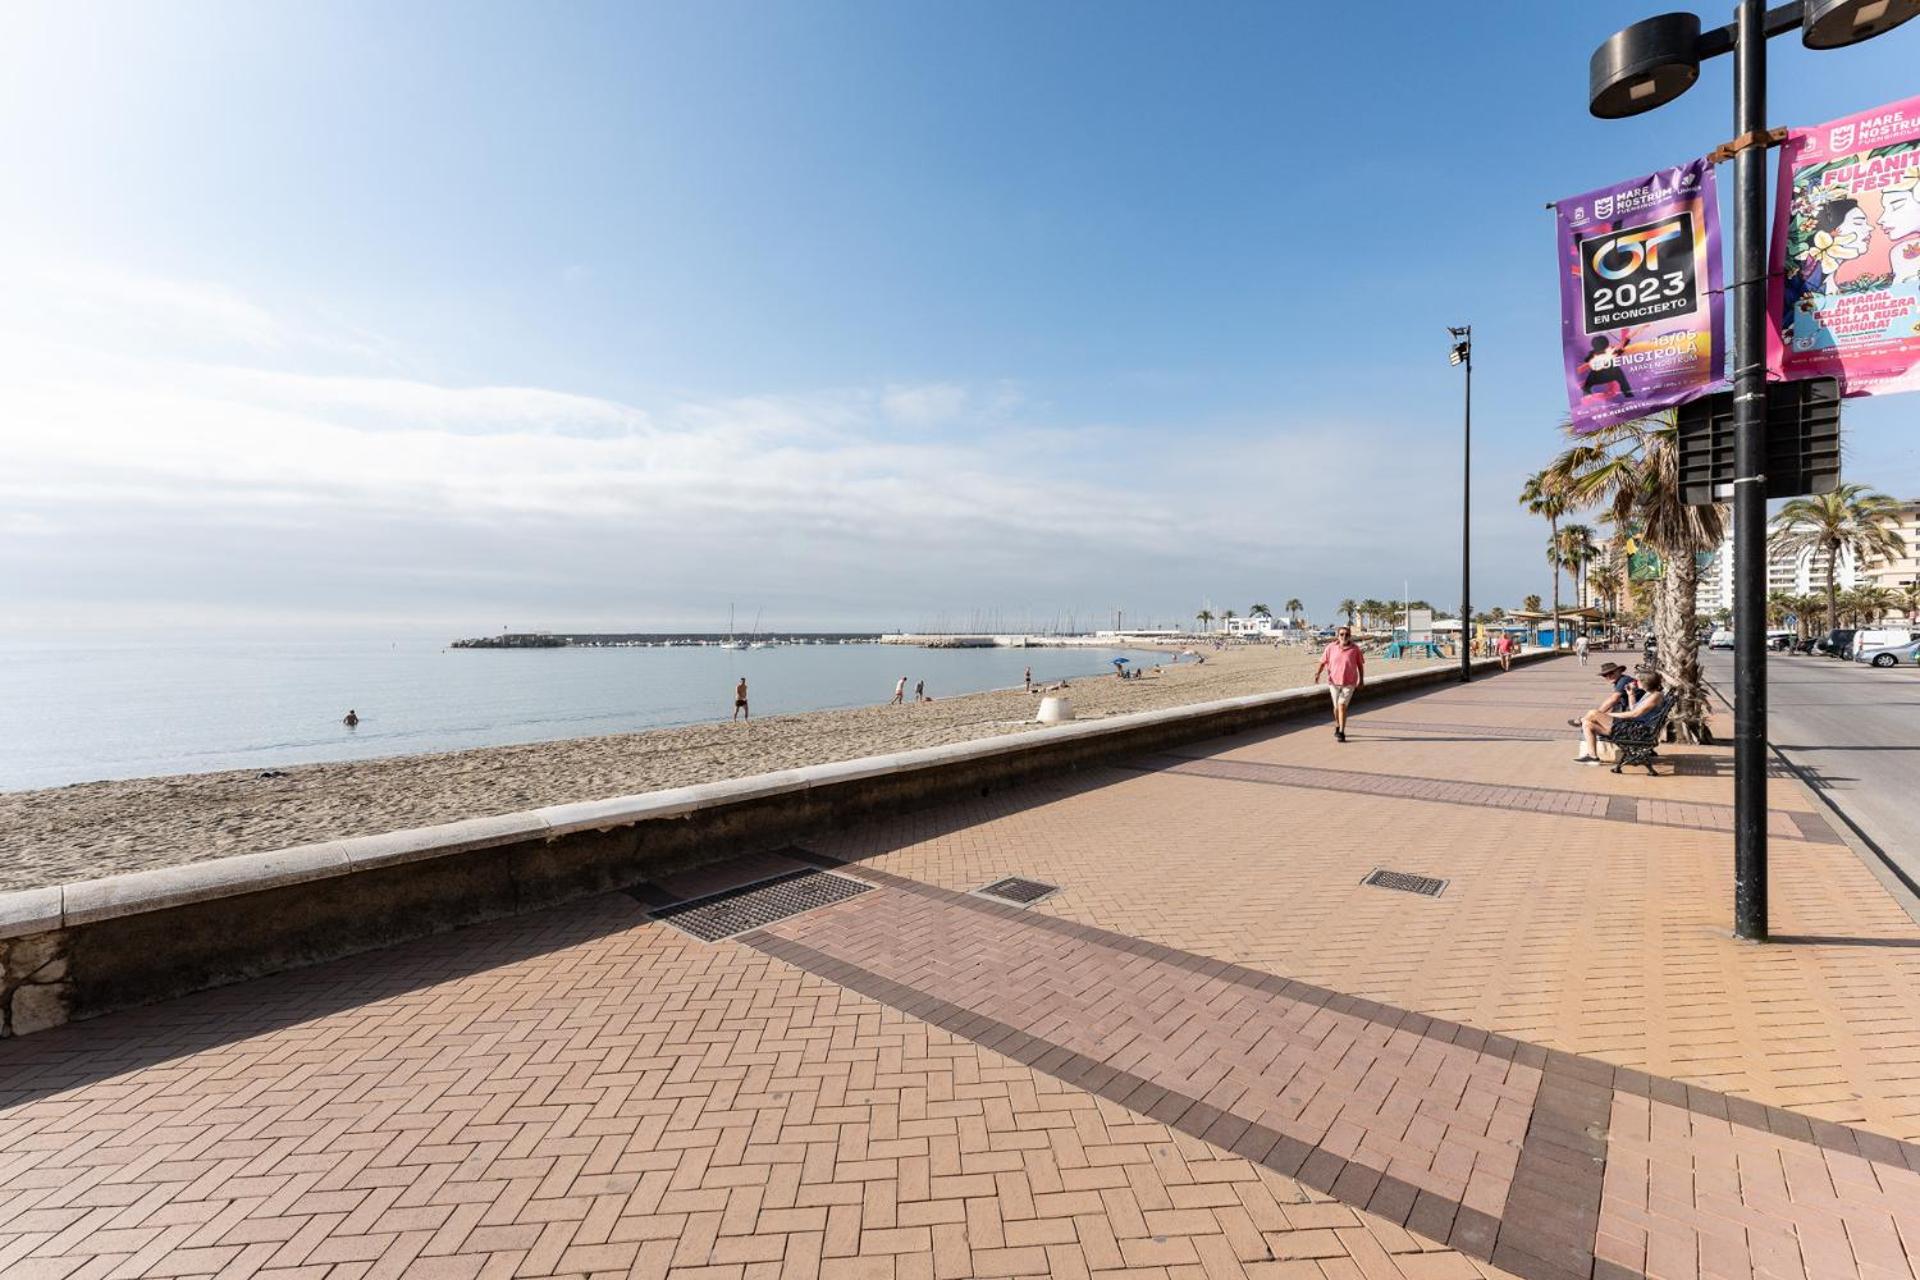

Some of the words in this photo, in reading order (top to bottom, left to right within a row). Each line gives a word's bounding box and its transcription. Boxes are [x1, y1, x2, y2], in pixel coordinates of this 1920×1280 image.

[1861, 111, 1904, 130] MARE
[1616, 186, 1649, 201] MARE
[1851, 170, 1906, 194] FEST
[1617, 187, 1672, 210] NOSTRUM
[1593, 270, 1685, 312] 2023
[1837, 292, 1891, 308] AMARAL
[1594, 314, 1610, 325] EN
[1612, 298, 1687, 321] CONCIERTO
[1873, 307, 1909, 320] RUSA
[1595, 342, 1697, 370] UENGIROLA
